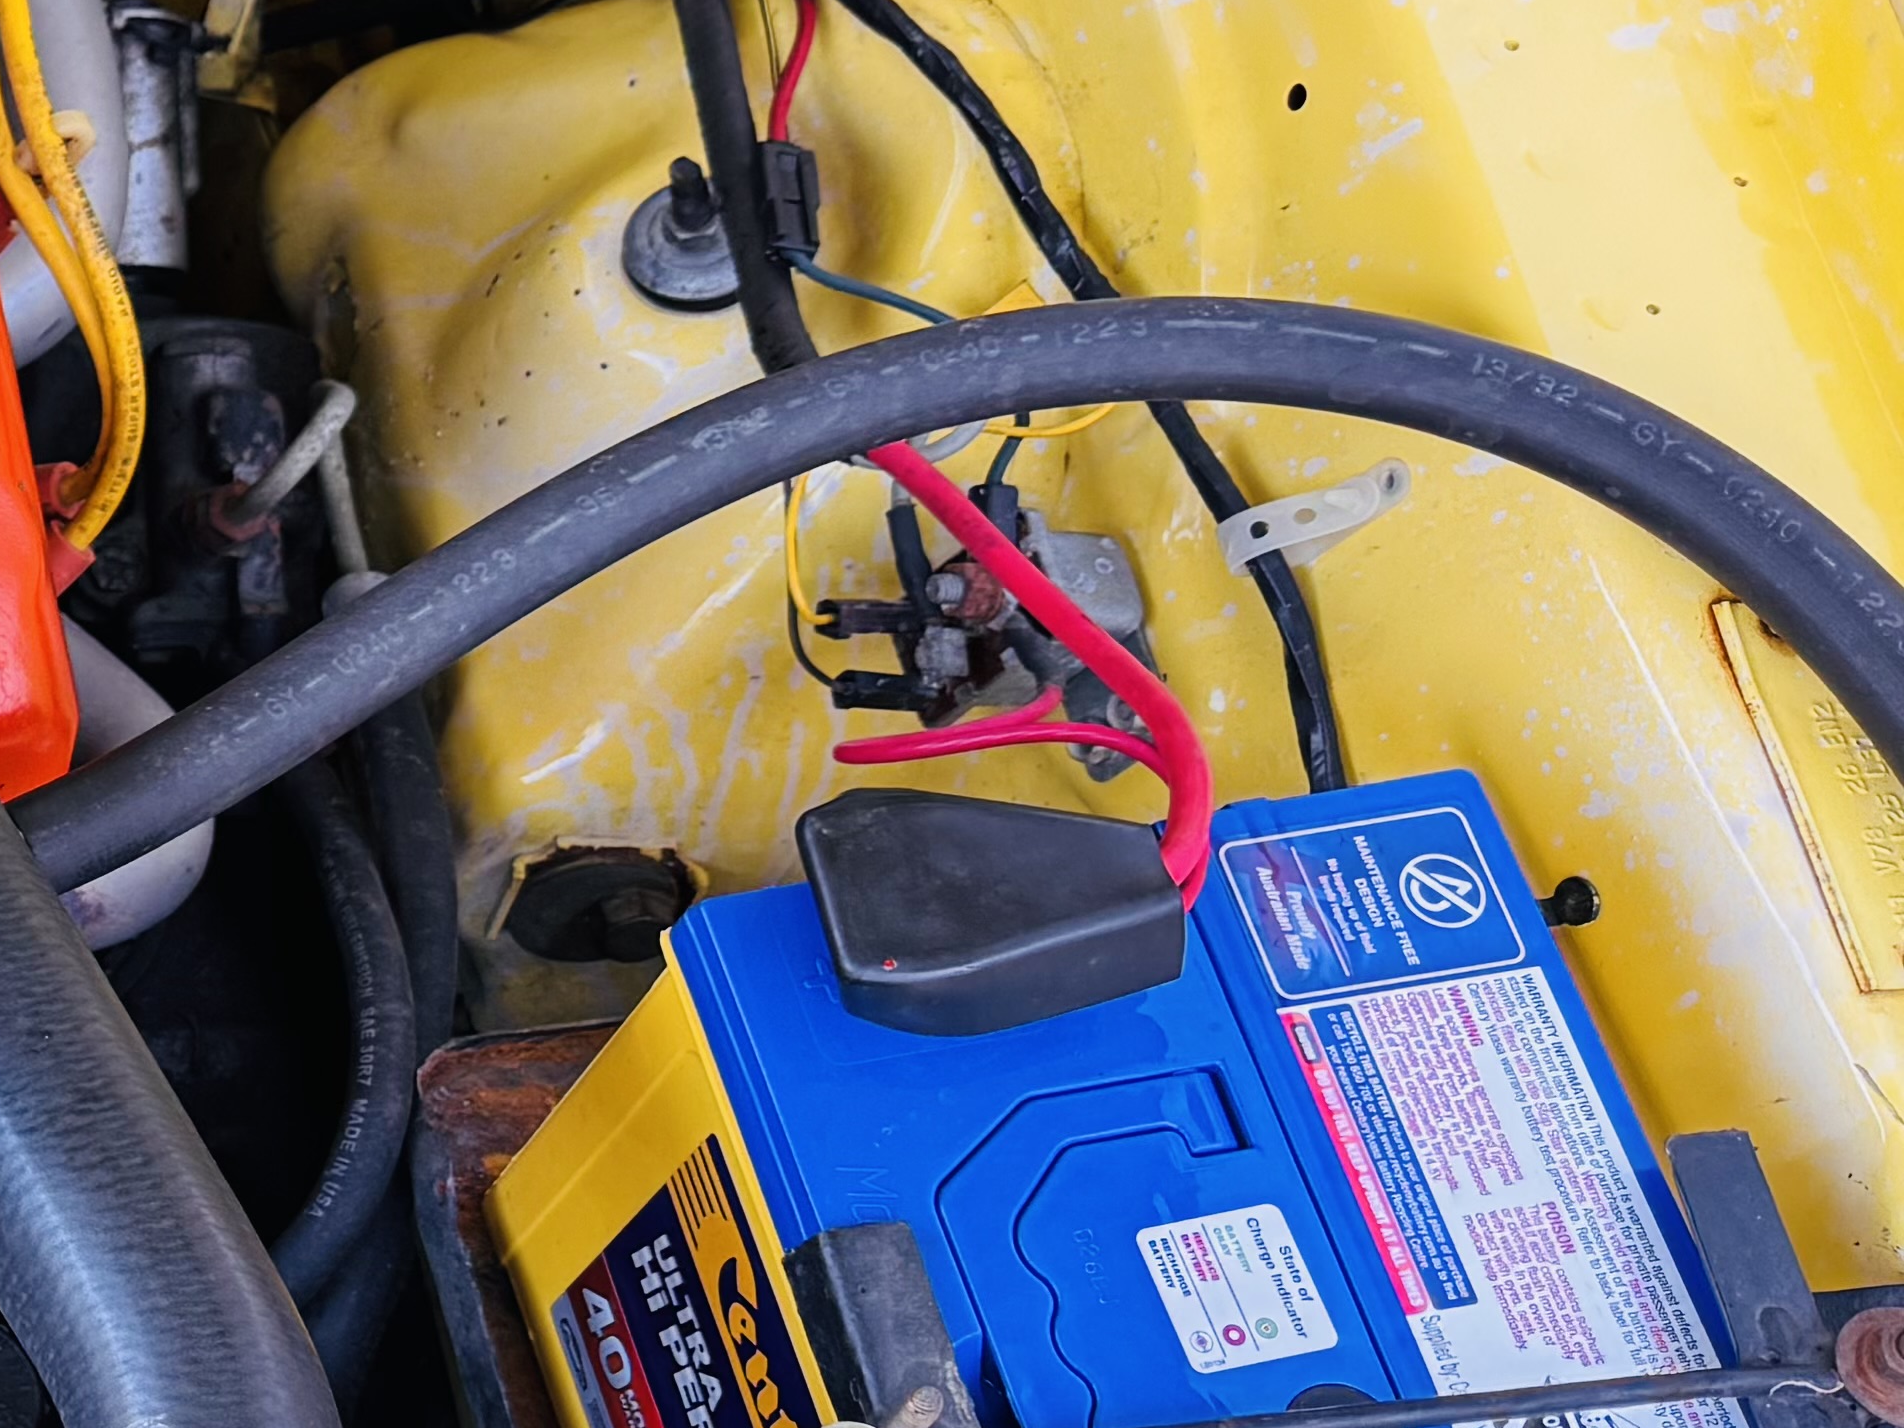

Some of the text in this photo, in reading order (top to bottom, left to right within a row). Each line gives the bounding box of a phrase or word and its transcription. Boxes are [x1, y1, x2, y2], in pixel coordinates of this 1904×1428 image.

[1254, 866, 1312, 972] Australian Made
[1284, 889, 1318, 940] Proudly
[1352, 834, 1420, 966] MAINTENANCE FREE
[1352, 876, 1385, 928] DESIGN
[1443, 983, 1486, 1048] WARNING
[1520, 972, 1560, 1038] WARRANTY
[1550, 1040, 1597, 1122] INFORMATION
[338, 1096, 371, 1154] MADE
[1587, 1123, 1608, 1146] This
[326, 1152, 350, 1182] IN
[1596, 1148, 1628, 1191] product
[307, 1178, 342, 1220] USA
[1539, 1199, 1577, 1256] POISON
[1180, 1234, 1207, 1283] BATTERY
[1623, 1204, 1660, 1263] warranted
[630, 1244, 671, 1313] Hi
[1147, 1240, 1175, 1289] BATTERY
[1245, 1216, 1308, 1340] Charge Indicator
[1277, 1244, 1314, 1303] State of
[1648, 1264, 1680, 1307] against
[581, 1287, 633, 1391] 40
[651, 1233, 724, 1414] ULTRA
[1414, 1313, 1457, 1363] Supplied
[1435, 1362, 1464, 1383] by:
